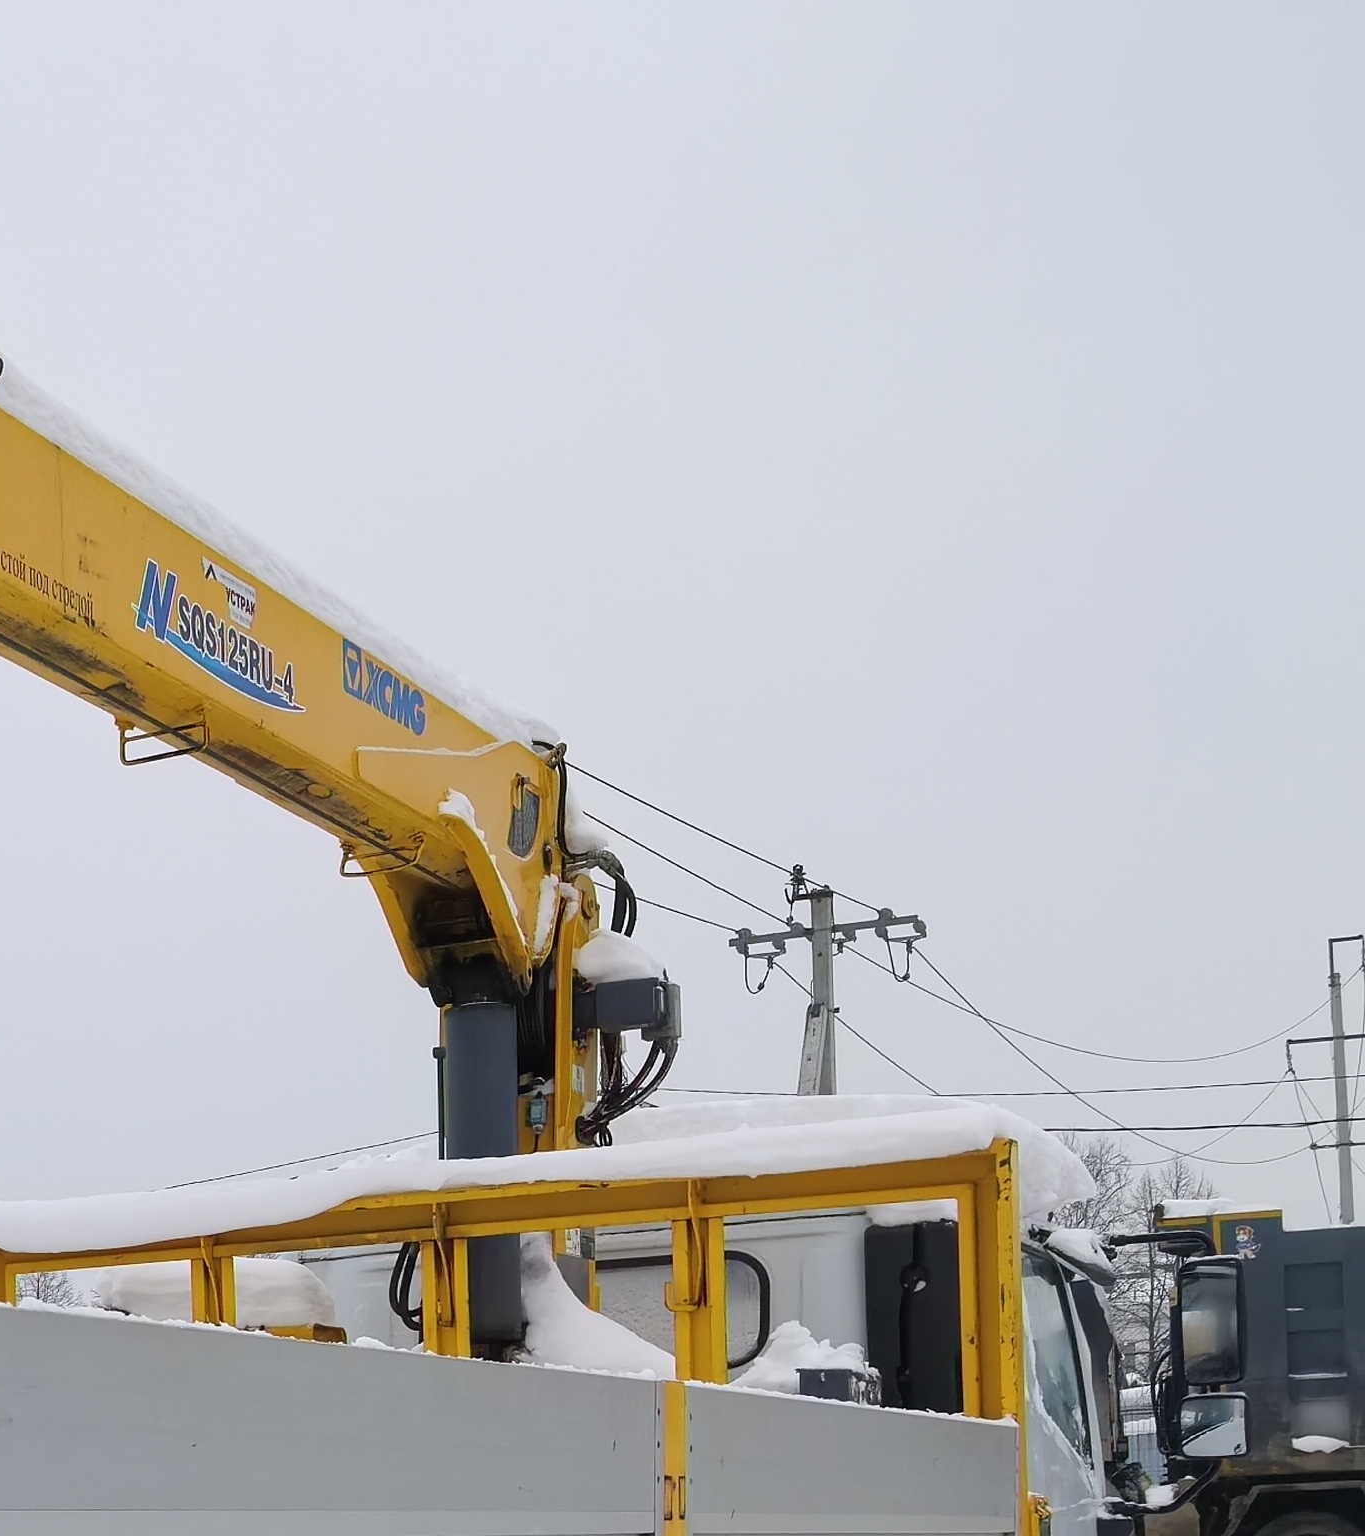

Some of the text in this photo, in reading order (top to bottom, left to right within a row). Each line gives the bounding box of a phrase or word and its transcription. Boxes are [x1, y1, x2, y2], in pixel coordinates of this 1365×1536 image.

[0, 551, 27, 582] стой
[29, 565, 50, 597] под
[52, 579, 95, 621] стрелой
[225, 586, 257, 616] УСТРАК
[177, 594, 295, 705] SQS125RU-4
[362, 657, 428, 737] XCMG
